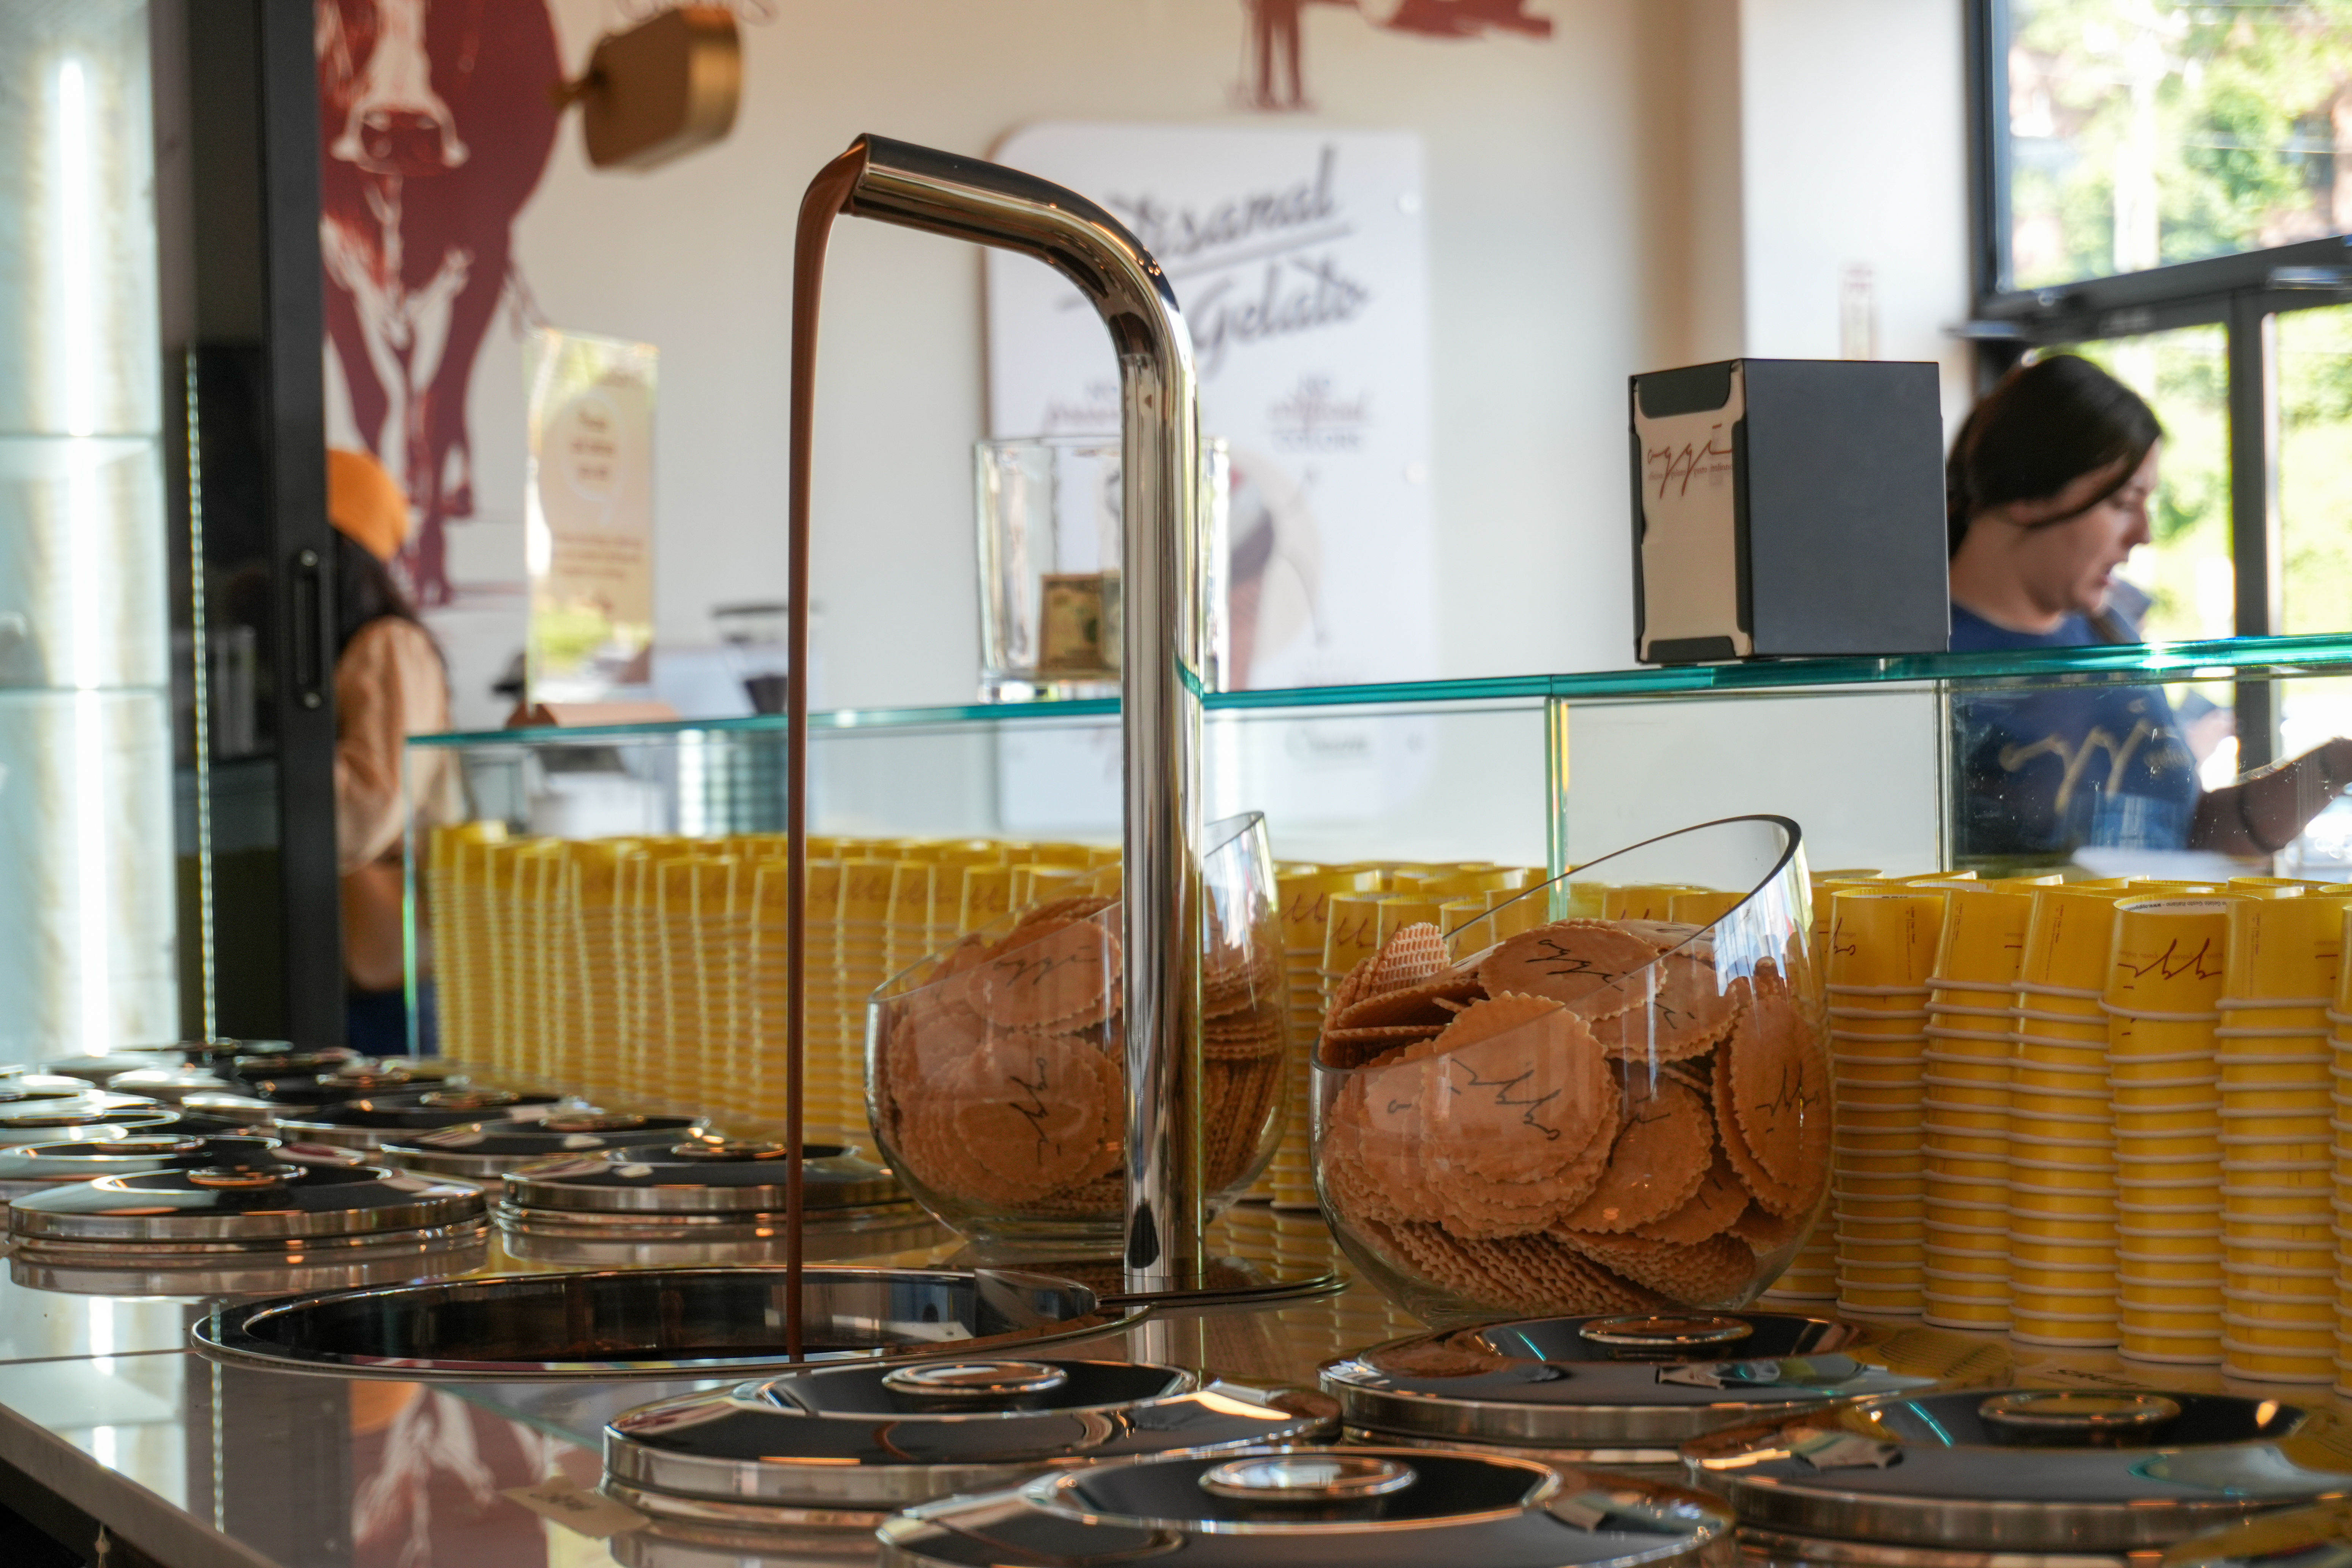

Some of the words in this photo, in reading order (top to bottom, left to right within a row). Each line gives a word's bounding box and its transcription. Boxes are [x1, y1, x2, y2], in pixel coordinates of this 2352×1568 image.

[1103, 141, 1338, 258] tisanal
[1647, 422, 1733, 499] oggi
[992, 944, 1098, 987] oggi
[2117, 937, 2223, 990] ggi
